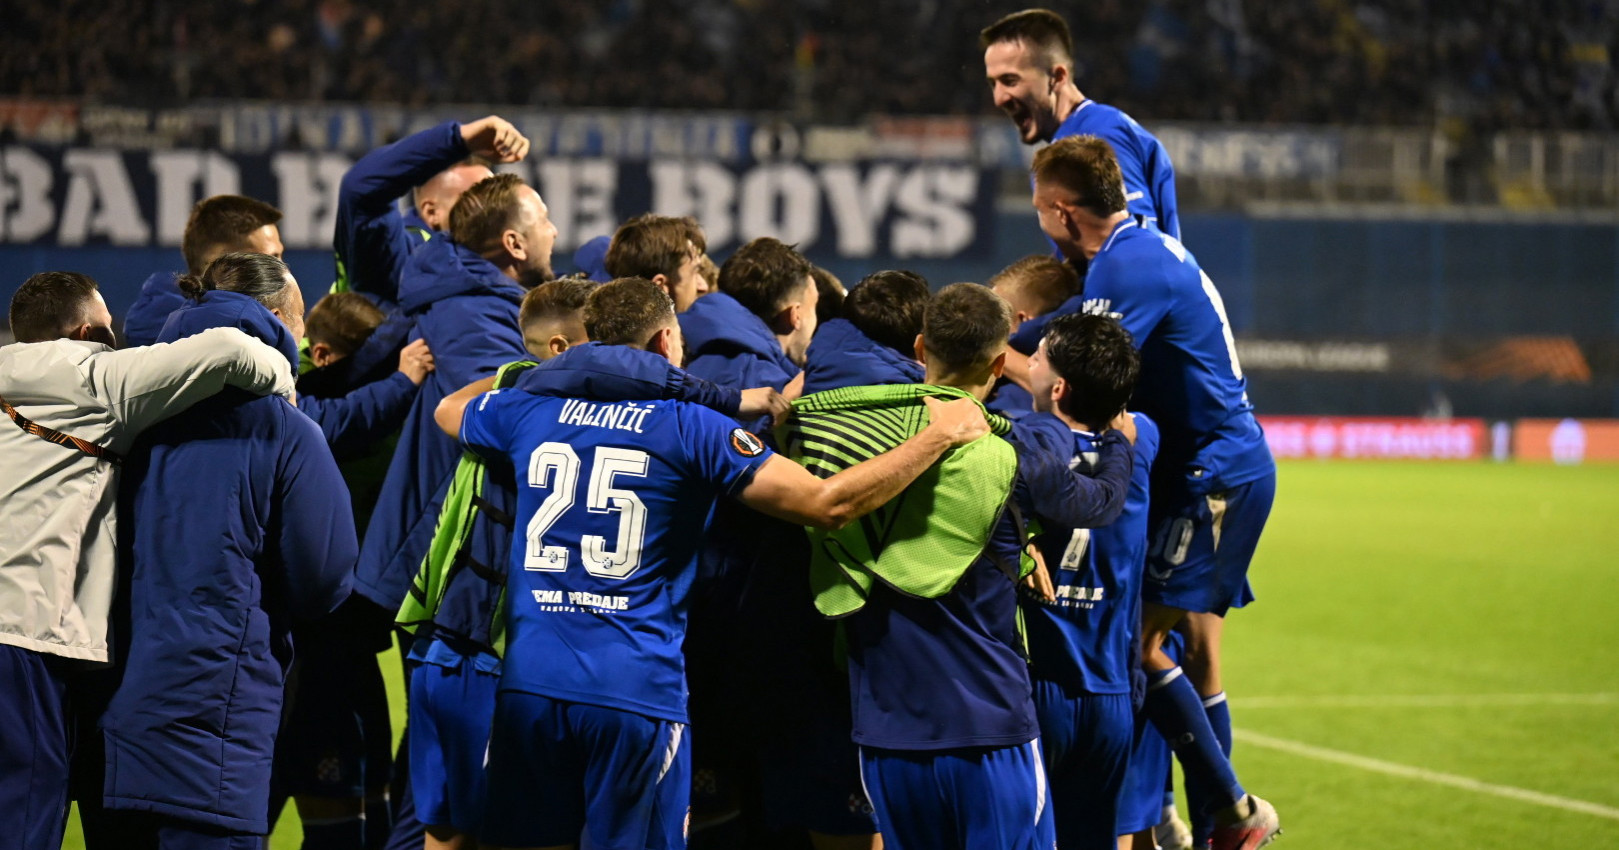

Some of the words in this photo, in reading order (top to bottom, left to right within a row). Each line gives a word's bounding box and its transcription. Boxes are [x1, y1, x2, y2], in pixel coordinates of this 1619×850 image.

[0, 147, 242, 248] BAD
[652, 159, 981, 259] BOYS
[558, 399, 655, 433] VALINČIĆ
[524, 441, 650, 580] 25
[567, 591, 630, 611] PREDAJE
